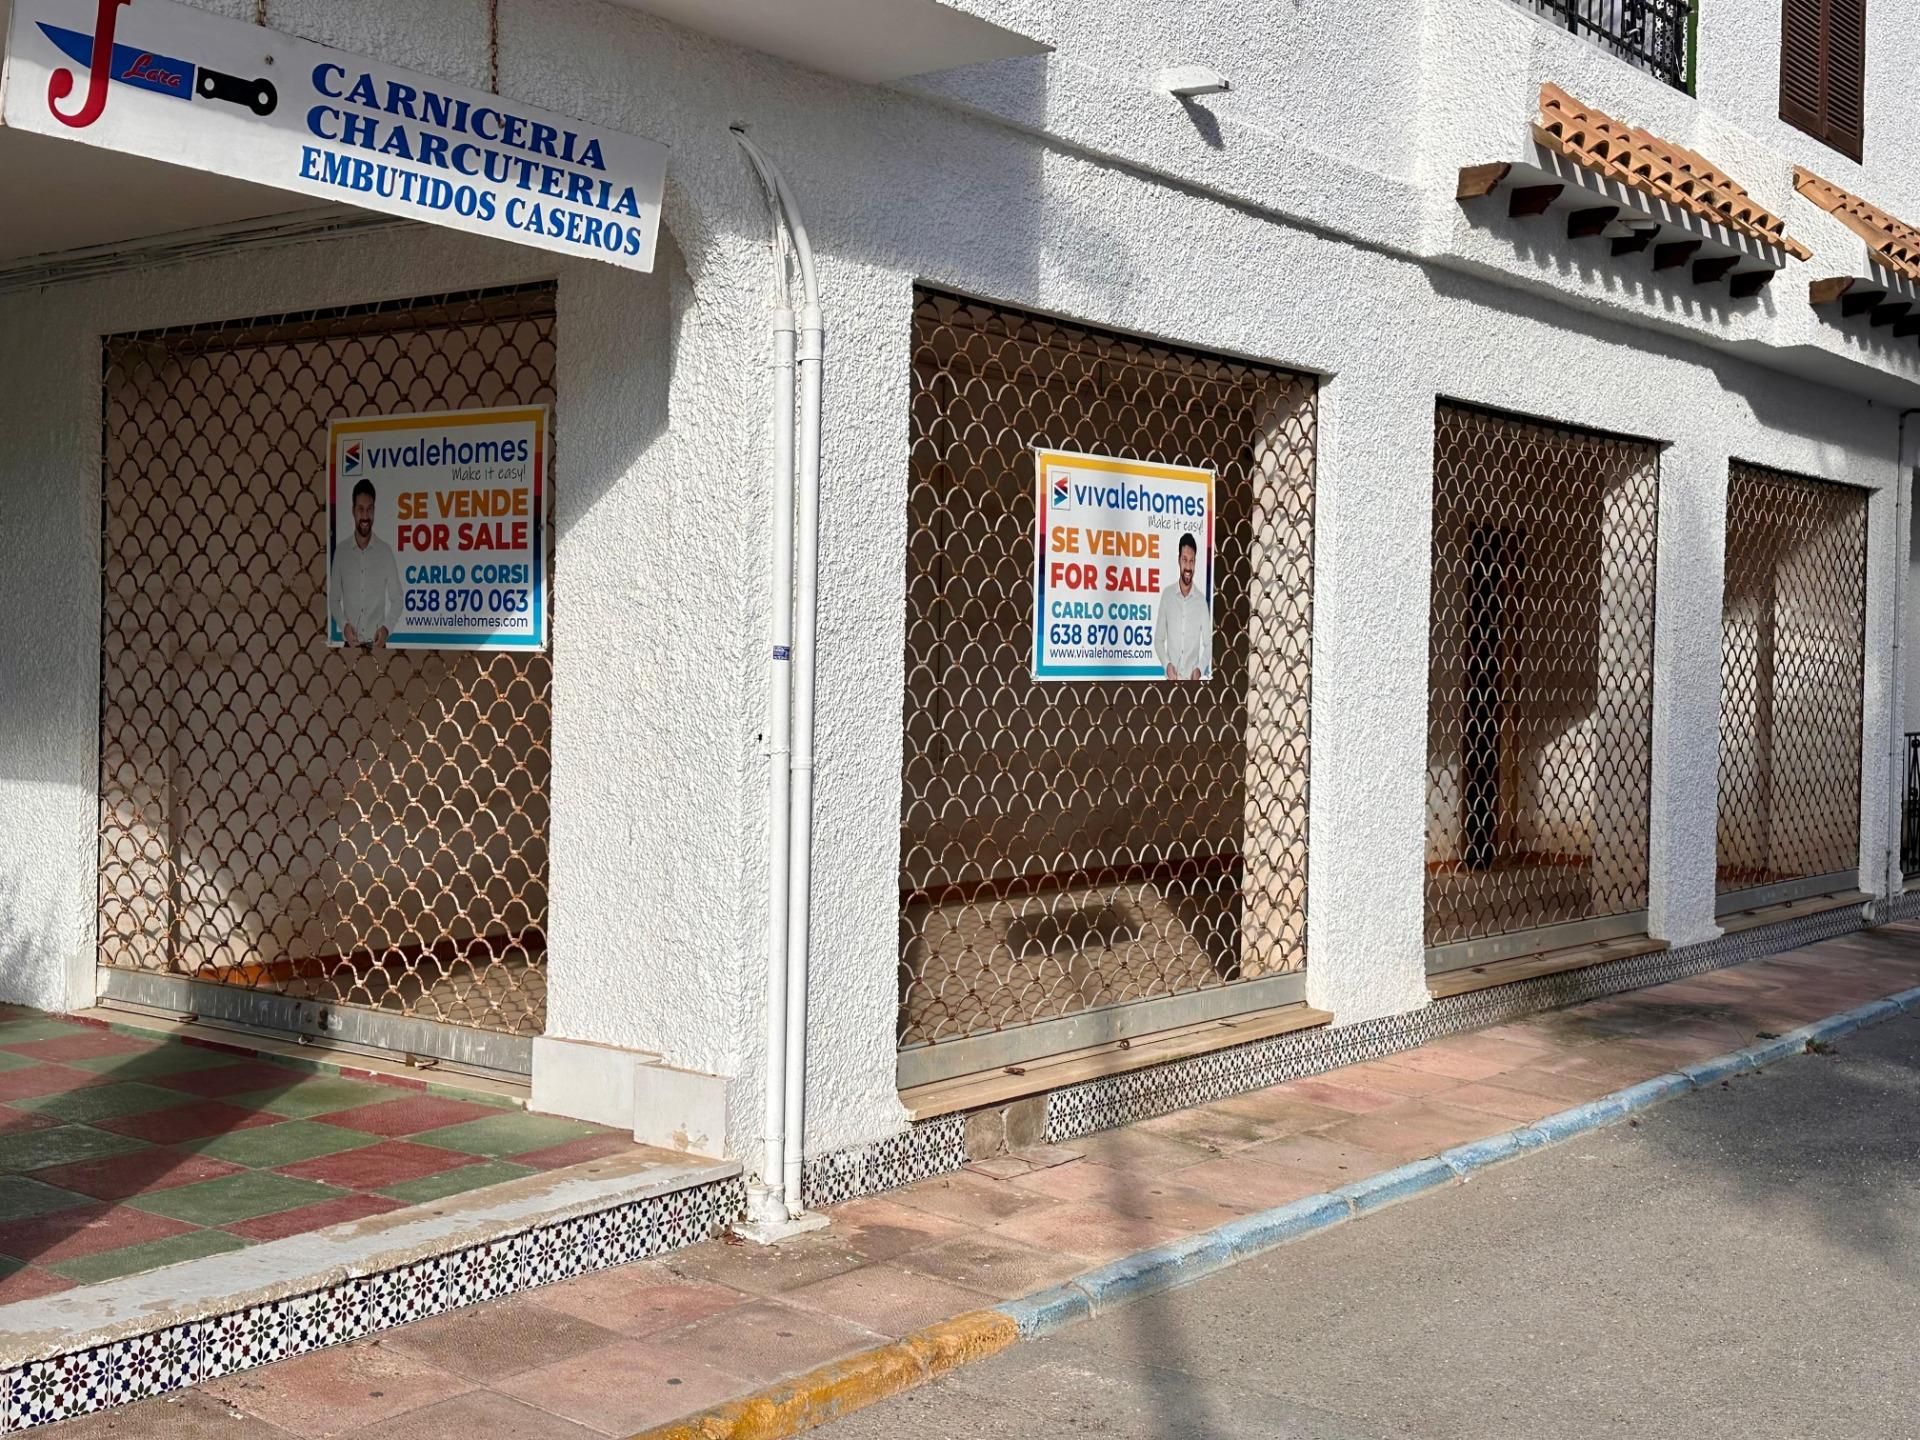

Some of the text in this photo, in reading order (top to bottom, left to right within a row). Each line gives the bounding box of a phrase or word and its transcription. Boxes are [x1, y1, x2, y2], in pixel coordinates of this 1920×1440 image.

[48, 0, 181, 128] J Lara
[312, 63, 606, 171] CARNICERIA
[307, 105, 641, 219] CHARCUTERIA
[299, 145, 641, 256] EMBUTIDOS CASEROS
[368, 437, 528, 468] vivalehomes
[452, 464, 526, 482] Make it easy!
[397, 488, 529, 520] SE VENDE
[1075, 482, 1204, 517] vivalehomes
[398, 522, 528, 552] FOR SALE
[1148, 514, 1203, 535] Make it easy!
[1051, 526, 1160, 559] SE VENDE
[405, 564, 529, 584] CARLO CORSI
[1050, 562, 1160, 593] FOR SALE
[405, 589, 528, 612] 638 870 063
[1051, 601, 1151, 621] CARLO CORSI
[406, 615, 528, 628] www.vivalehomes.com
[1050, 623, 1152, 646] 638 870 063
[1050, 647, 1152, 659] www.vivalehomes.com
